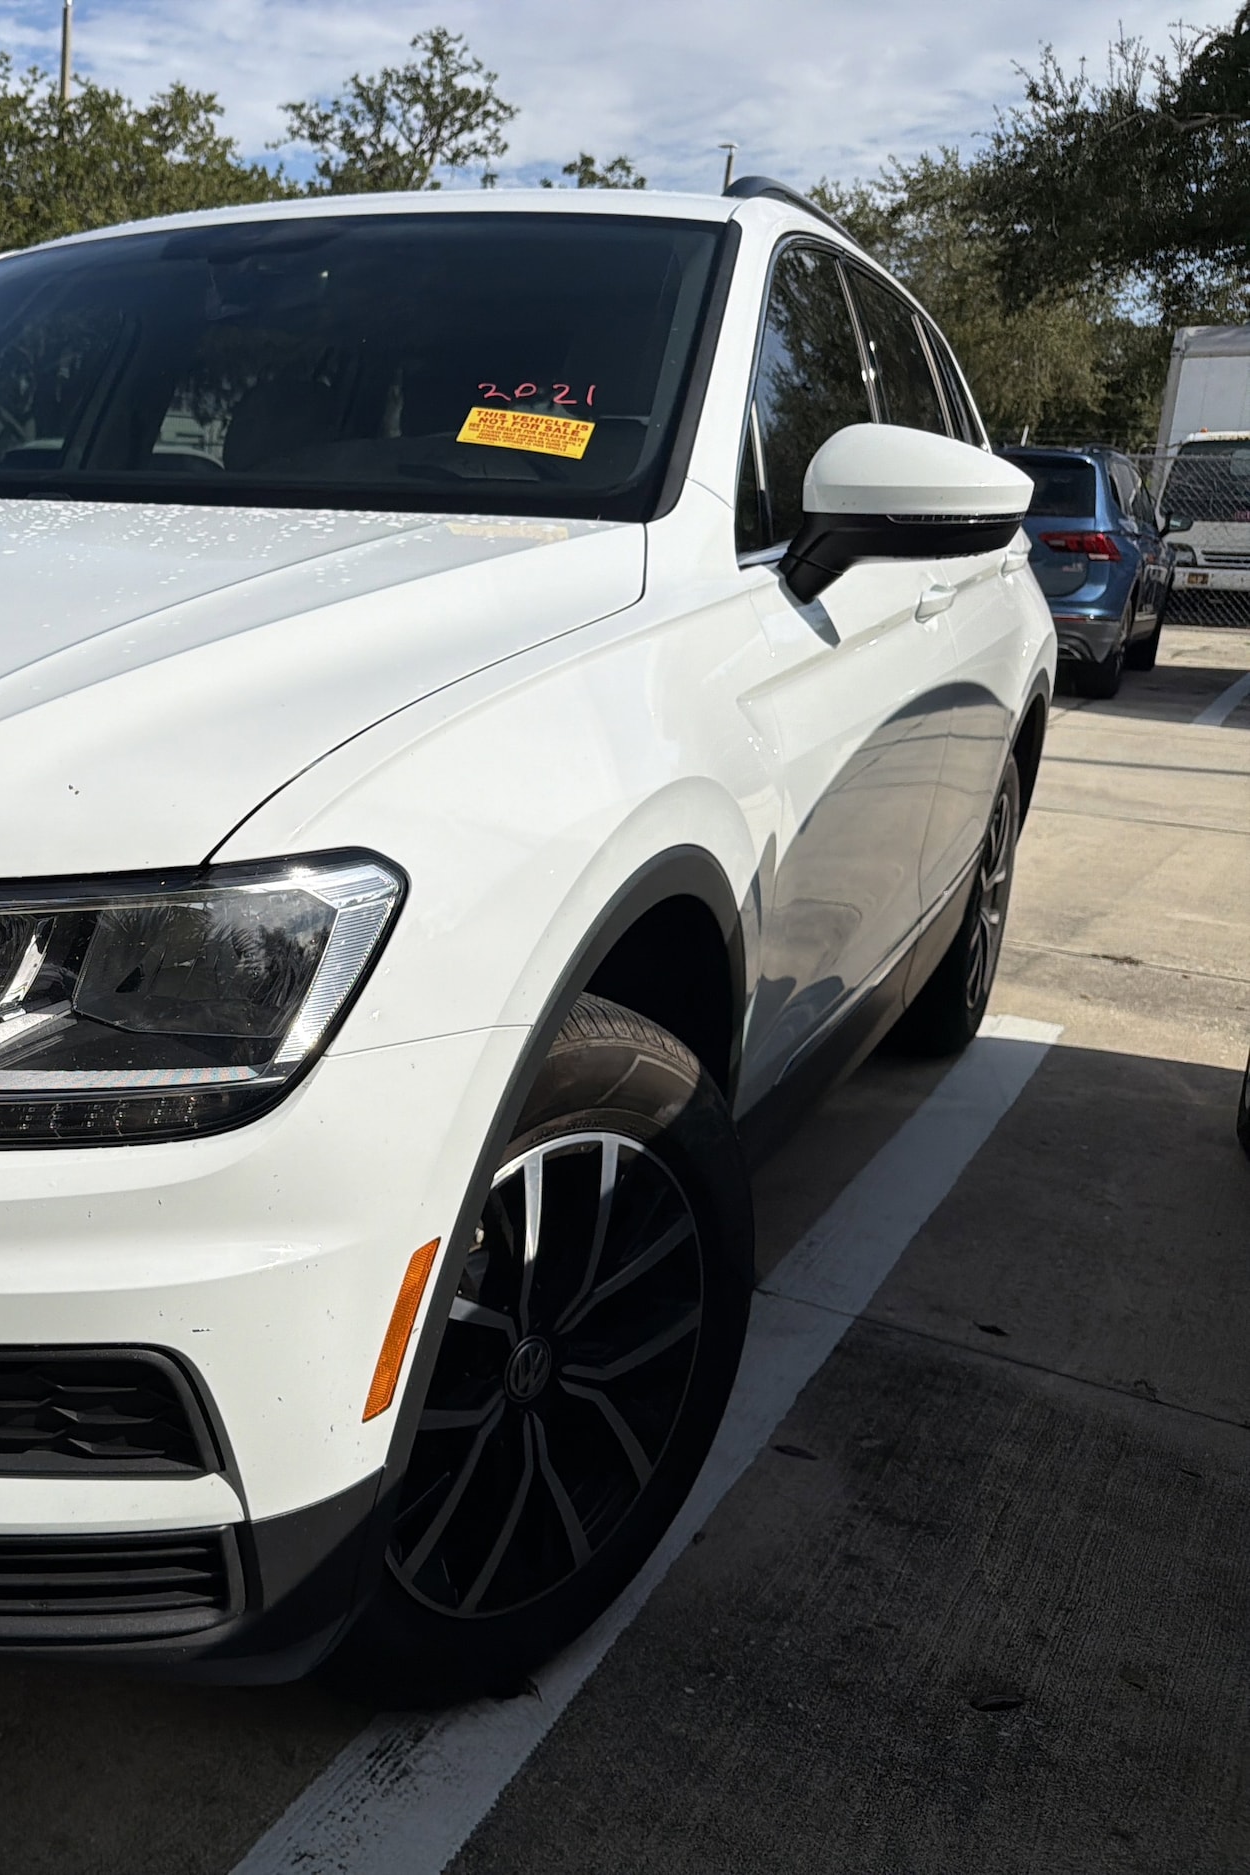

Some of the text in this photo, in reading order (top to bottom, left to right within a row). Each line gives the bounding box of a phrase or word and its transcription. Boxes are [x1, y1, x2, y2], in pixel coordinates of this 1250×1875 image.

[478, 383, 596, 406] 2021
[476, 410, 589, 431] THIS VEHICLE IS
[478, 417, 508, 426] NOT
[511, 421, 540, 431] FOR
[544, 425, 581, 437] SALE
